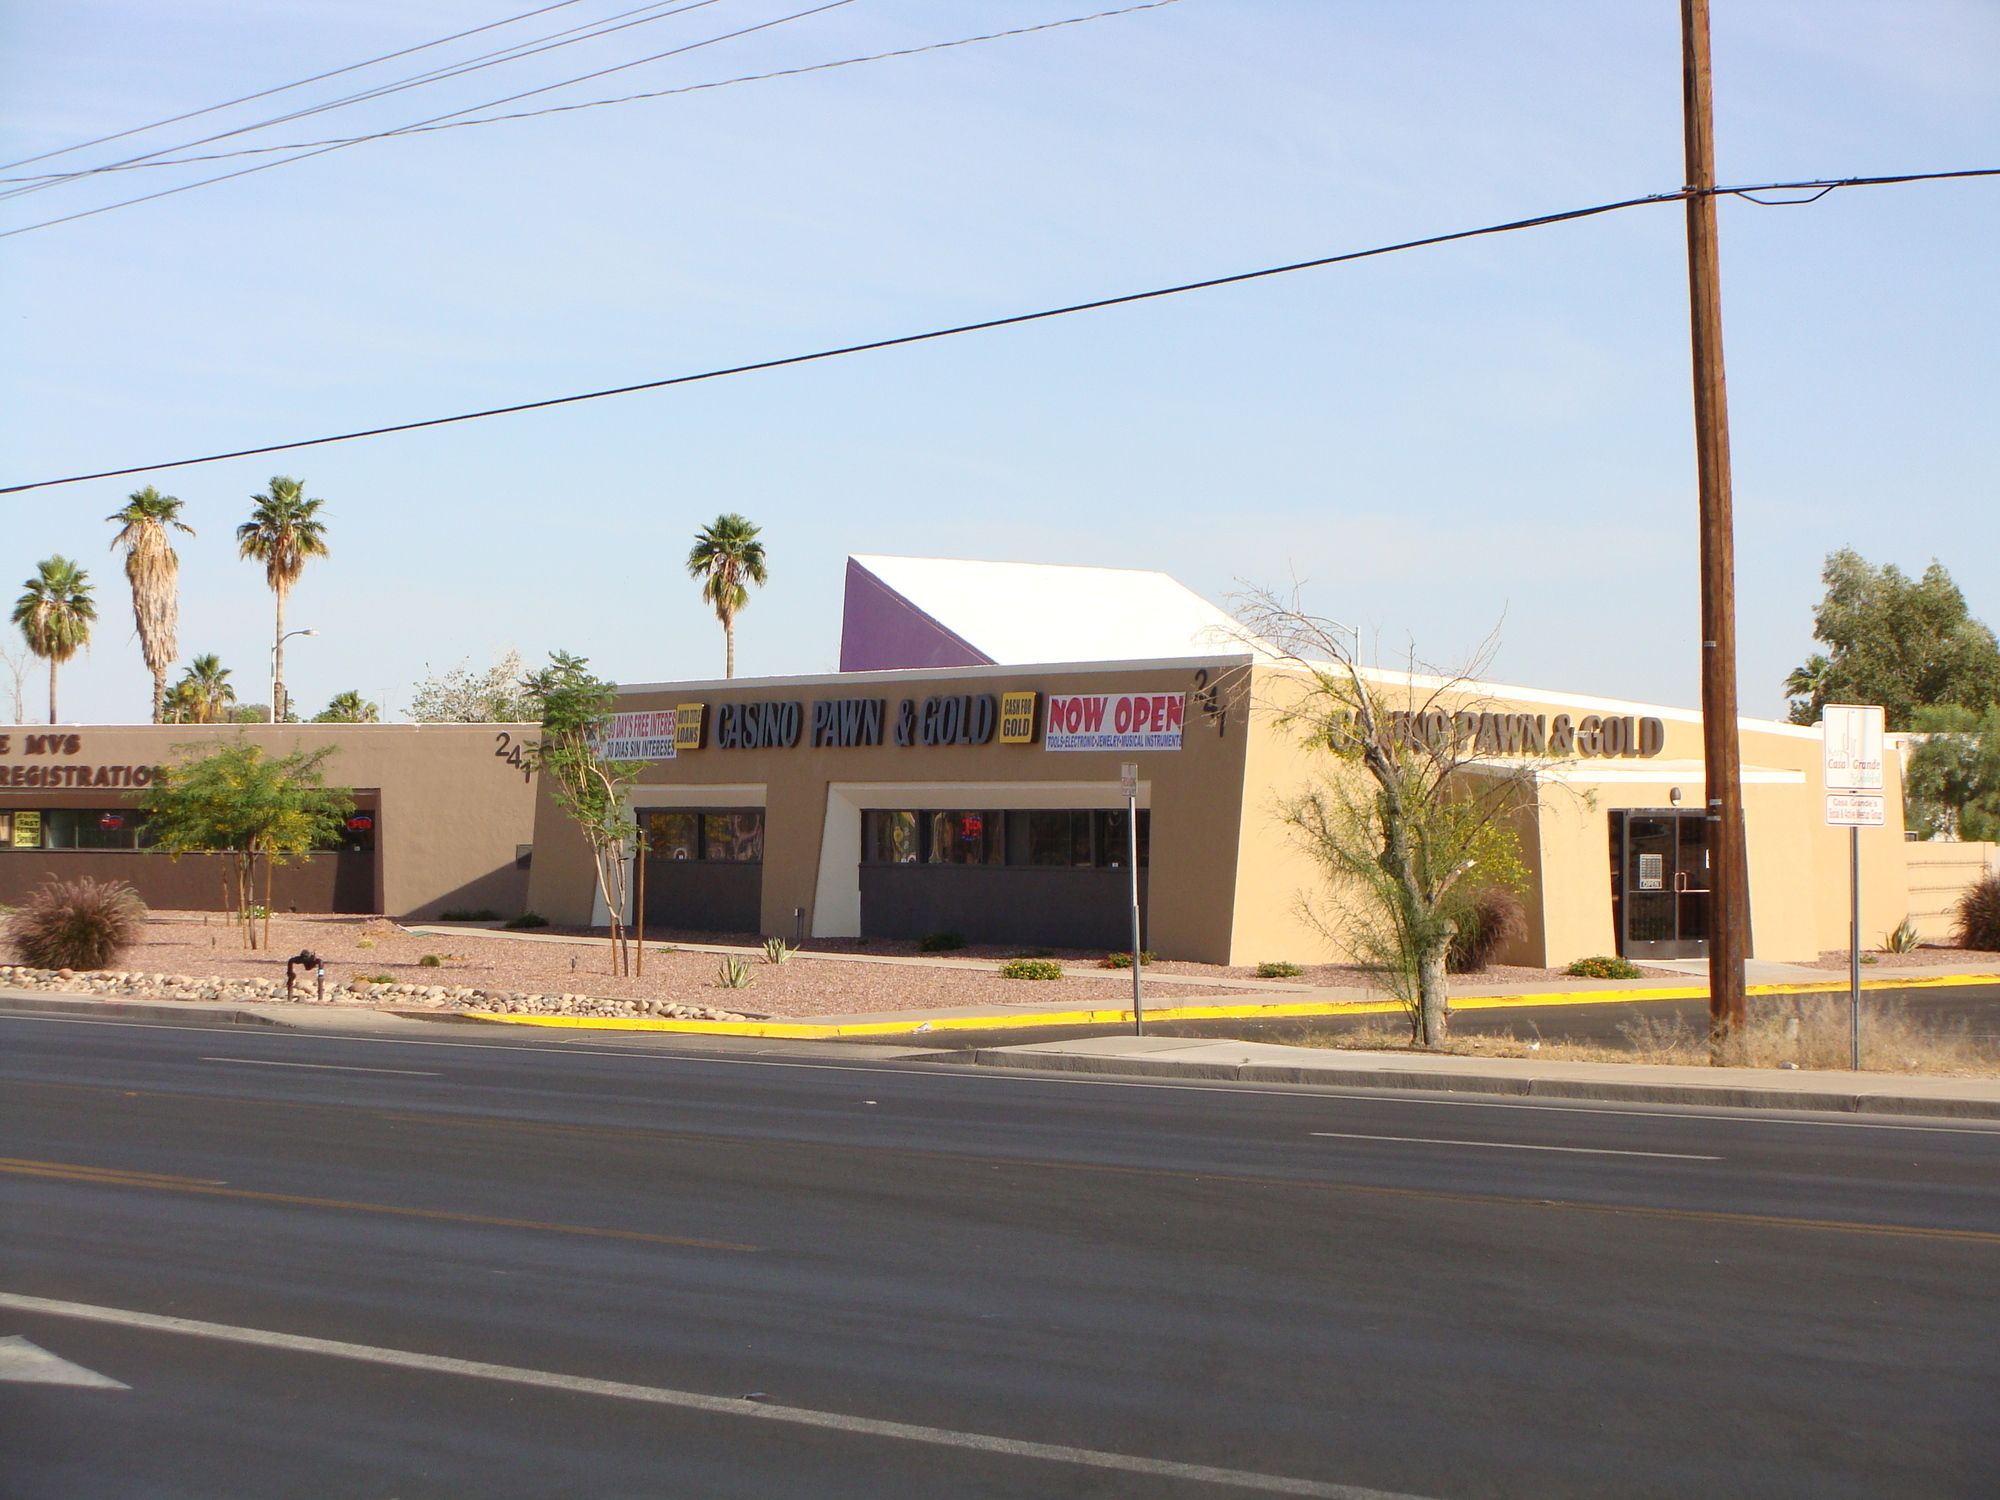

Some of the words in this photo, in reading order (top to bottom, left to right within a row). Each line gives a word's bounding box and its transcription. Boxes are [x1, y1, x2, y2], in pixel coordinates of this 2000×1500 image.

[1004, 698, 1020, 716] CASH
[1020, 698, 1032, 715] FOR
[1049, 697, 1107, 734] NOW
[1115, 695, 1184, 734] OPEN
[1194, 669, 1227, 738] 241
[634, 713, 650, 737] FREE
[716, 702, 802, 749] CASINO
[810, 699, 887, 748] PAWN
[895, 700, 916, 747] &
[920, 694, 998, 745] GOLD
[1003, 718, 1031, 737] GOLD
[24, 734, 81, 756] MVS
[676, 726, 699, 743] LOANS
[1454, 711, 1547, 756] PAWN
[1548, 713, 1575, 757] &
[1577, 715, 1665, 758] GOLD
[495, 732, 531, 784] 241
[614, 740, 629, 758] DIAS
[630, 739, 642, 757] SIN
[642, 738, 675, 757] INTERESES
[1828, 758, 1846, 769] Casa
[1852, 759, 1881, 770] Grande
